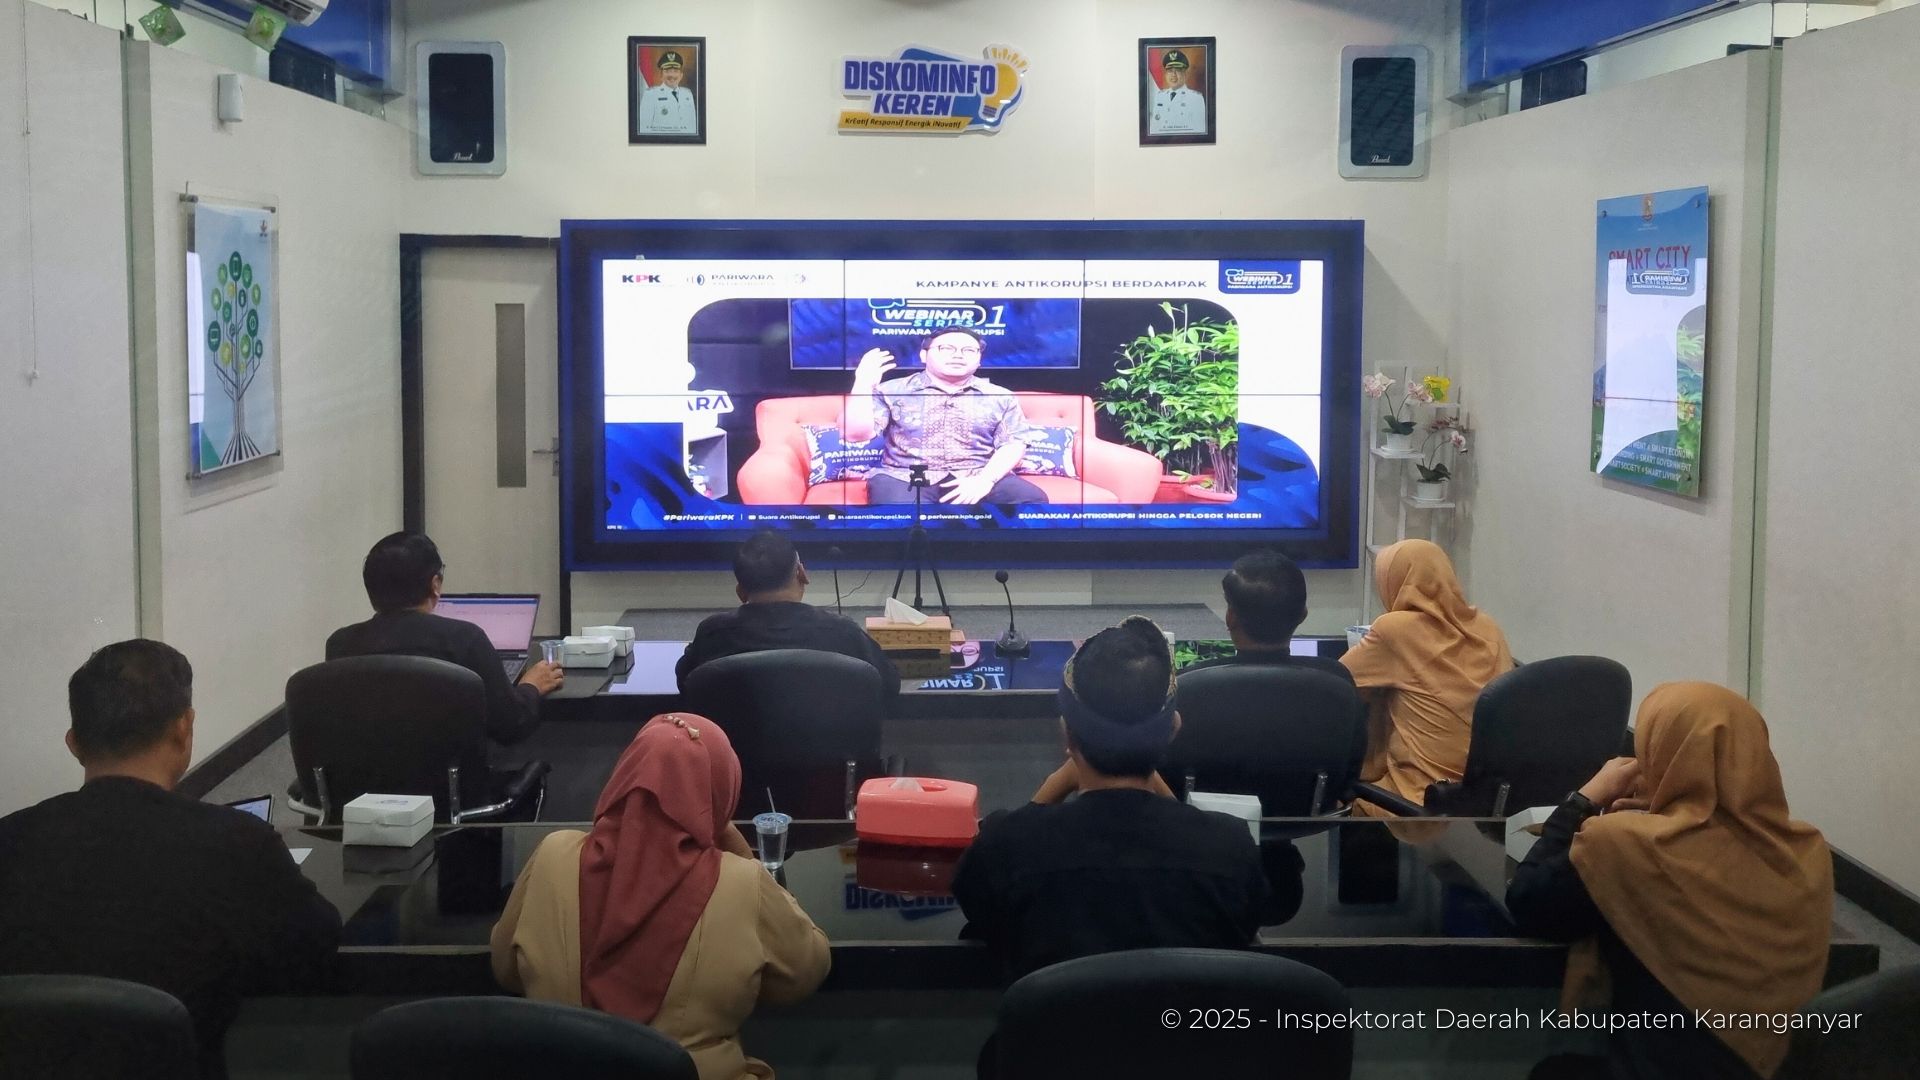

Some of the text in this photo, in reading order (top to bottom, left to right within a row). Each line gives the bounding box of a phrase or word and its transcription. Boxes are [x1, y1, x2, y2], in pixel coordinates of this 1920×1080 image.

[845, 61, 995, 94] DISKOMINFO
[874, 93, 952, 116] KEREN
[870, 118, 904, 127] Responsif
[905, 120, 931, 128] Energik
[1656, 246, 1690, 269] CITY
[622, 274, 660, 283] KPK
[916, 280, 1208, 288] KAMPANYE ANTIKORUPSI BERDAMPAK
[884, 306, 1006, 328] WEBINAR 1
[913, 320, 974, 328] SERIES
[872, 328, 932, 336] PARIWARA
